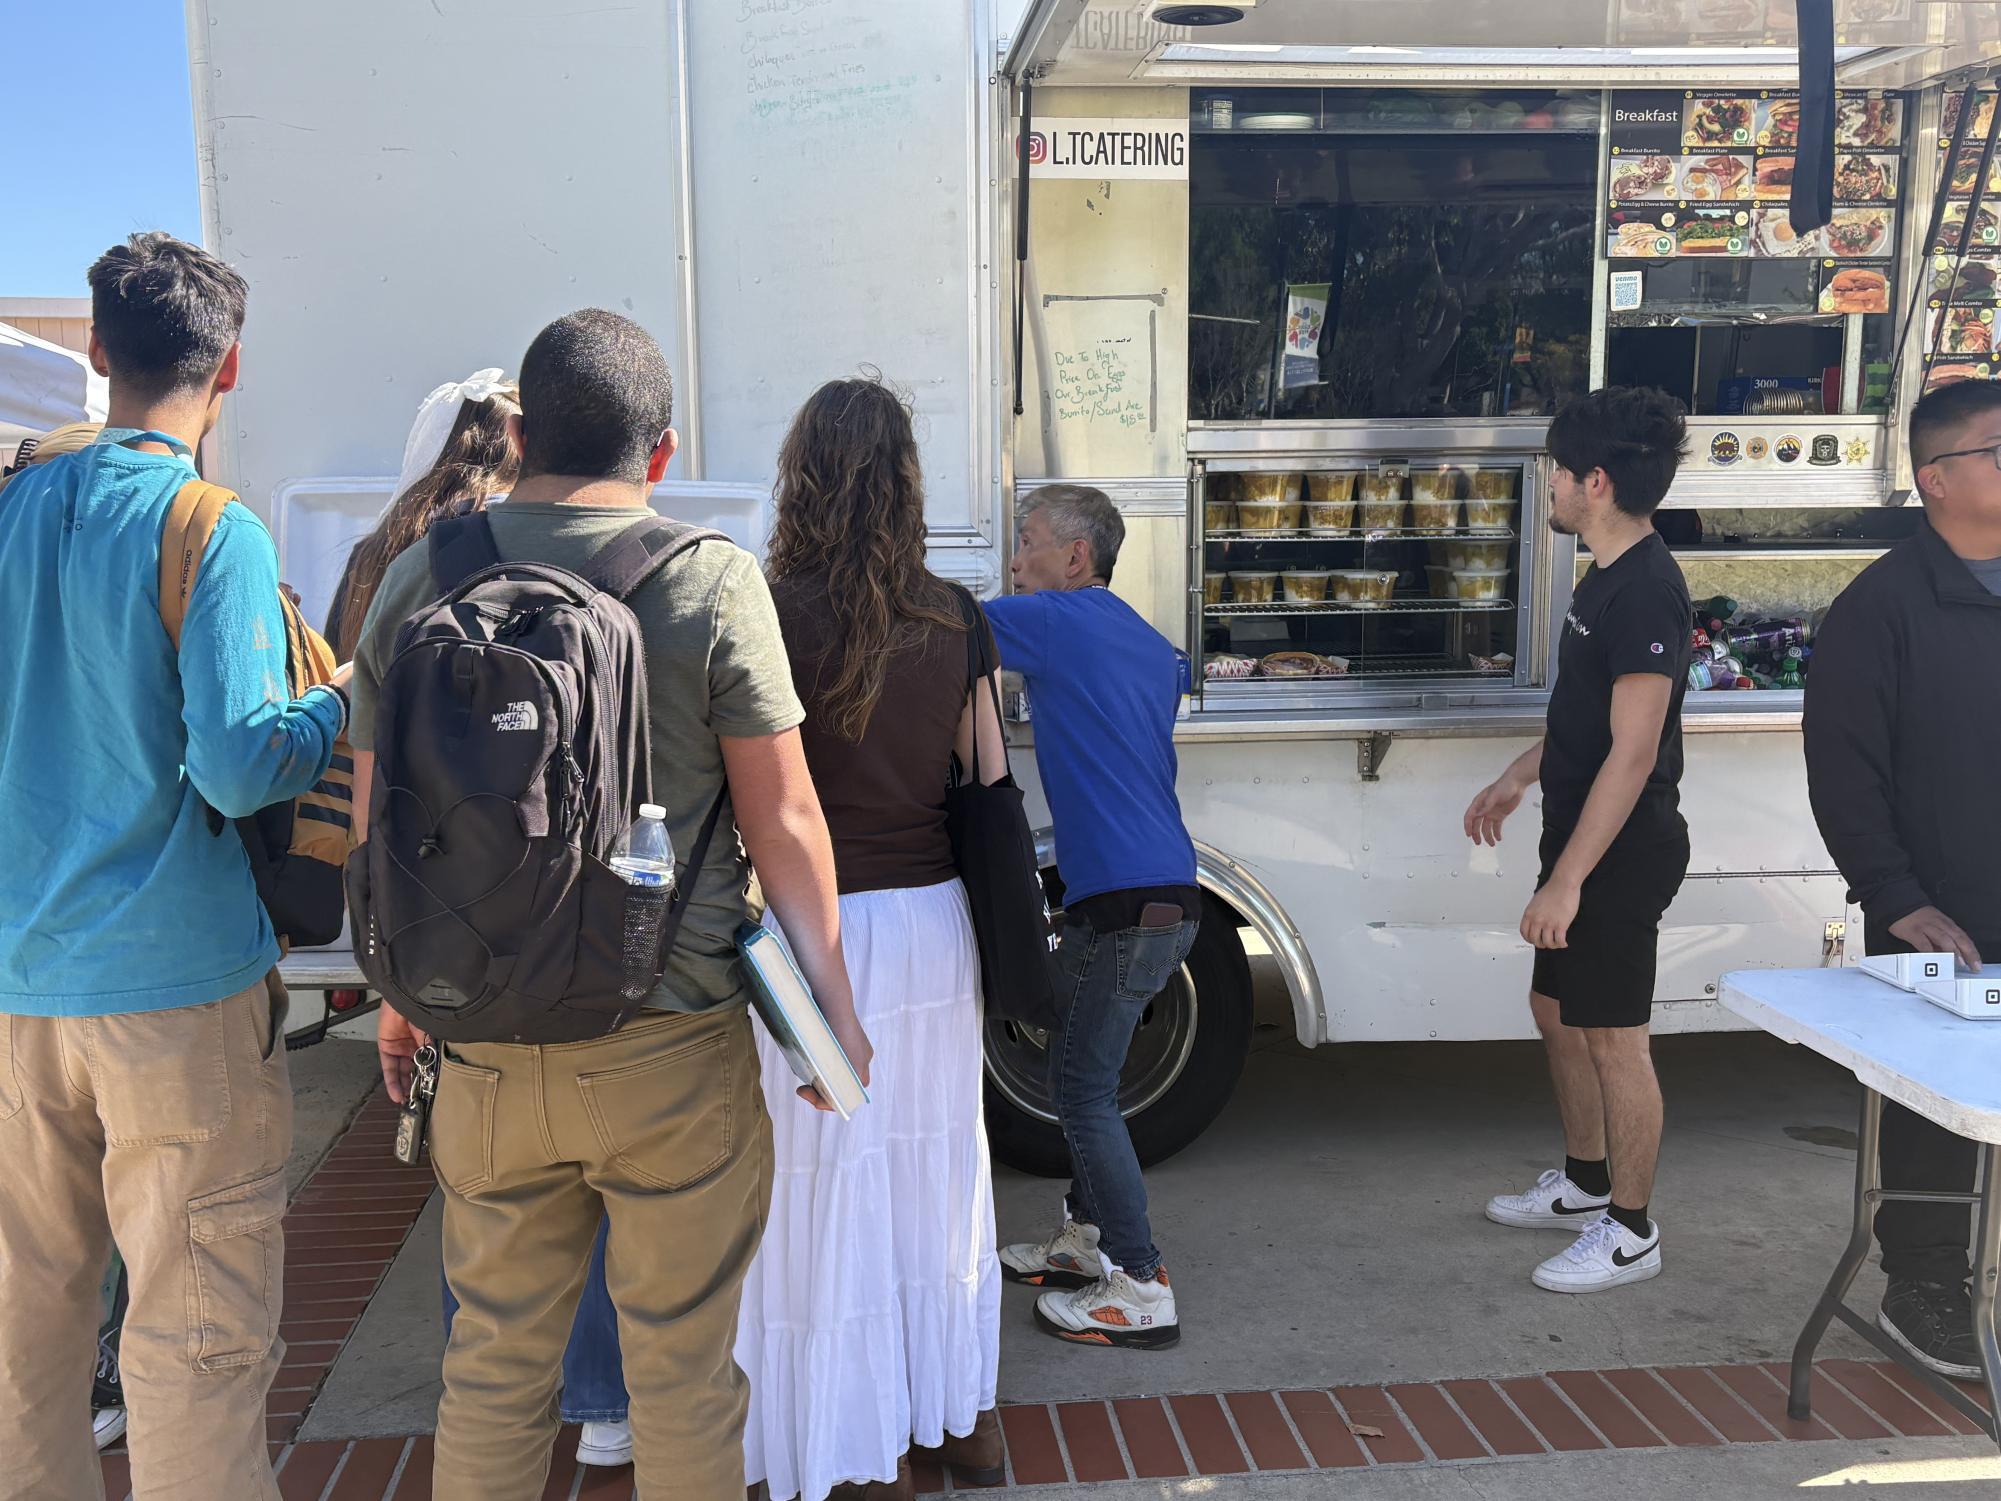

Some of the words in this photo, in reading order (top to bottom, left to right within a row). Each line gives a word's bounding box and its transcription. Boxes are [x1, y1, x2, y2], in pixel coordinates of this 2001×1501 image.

[1615, 109, 1678, 122] Breakfast
[1053, 132, 1184, 165] L.TCATERING
[1055, 352, 1074, 366] Due
[1078, 351, 1089, 361] To
[1096, 348, 1119, 369] High
[1087, 368, 1100, 380] On
[1753, 379, 1778, 389] 3000
[1055, 389, 1071, 399] Our
[182, 549, 193, 584] adidas
[507, 701, 525, 712] THE
[491, 711, 523, 723] NORTH
[497, 721, 521, 732] FACE
[1140, 1315, 1152, 1325] 23
